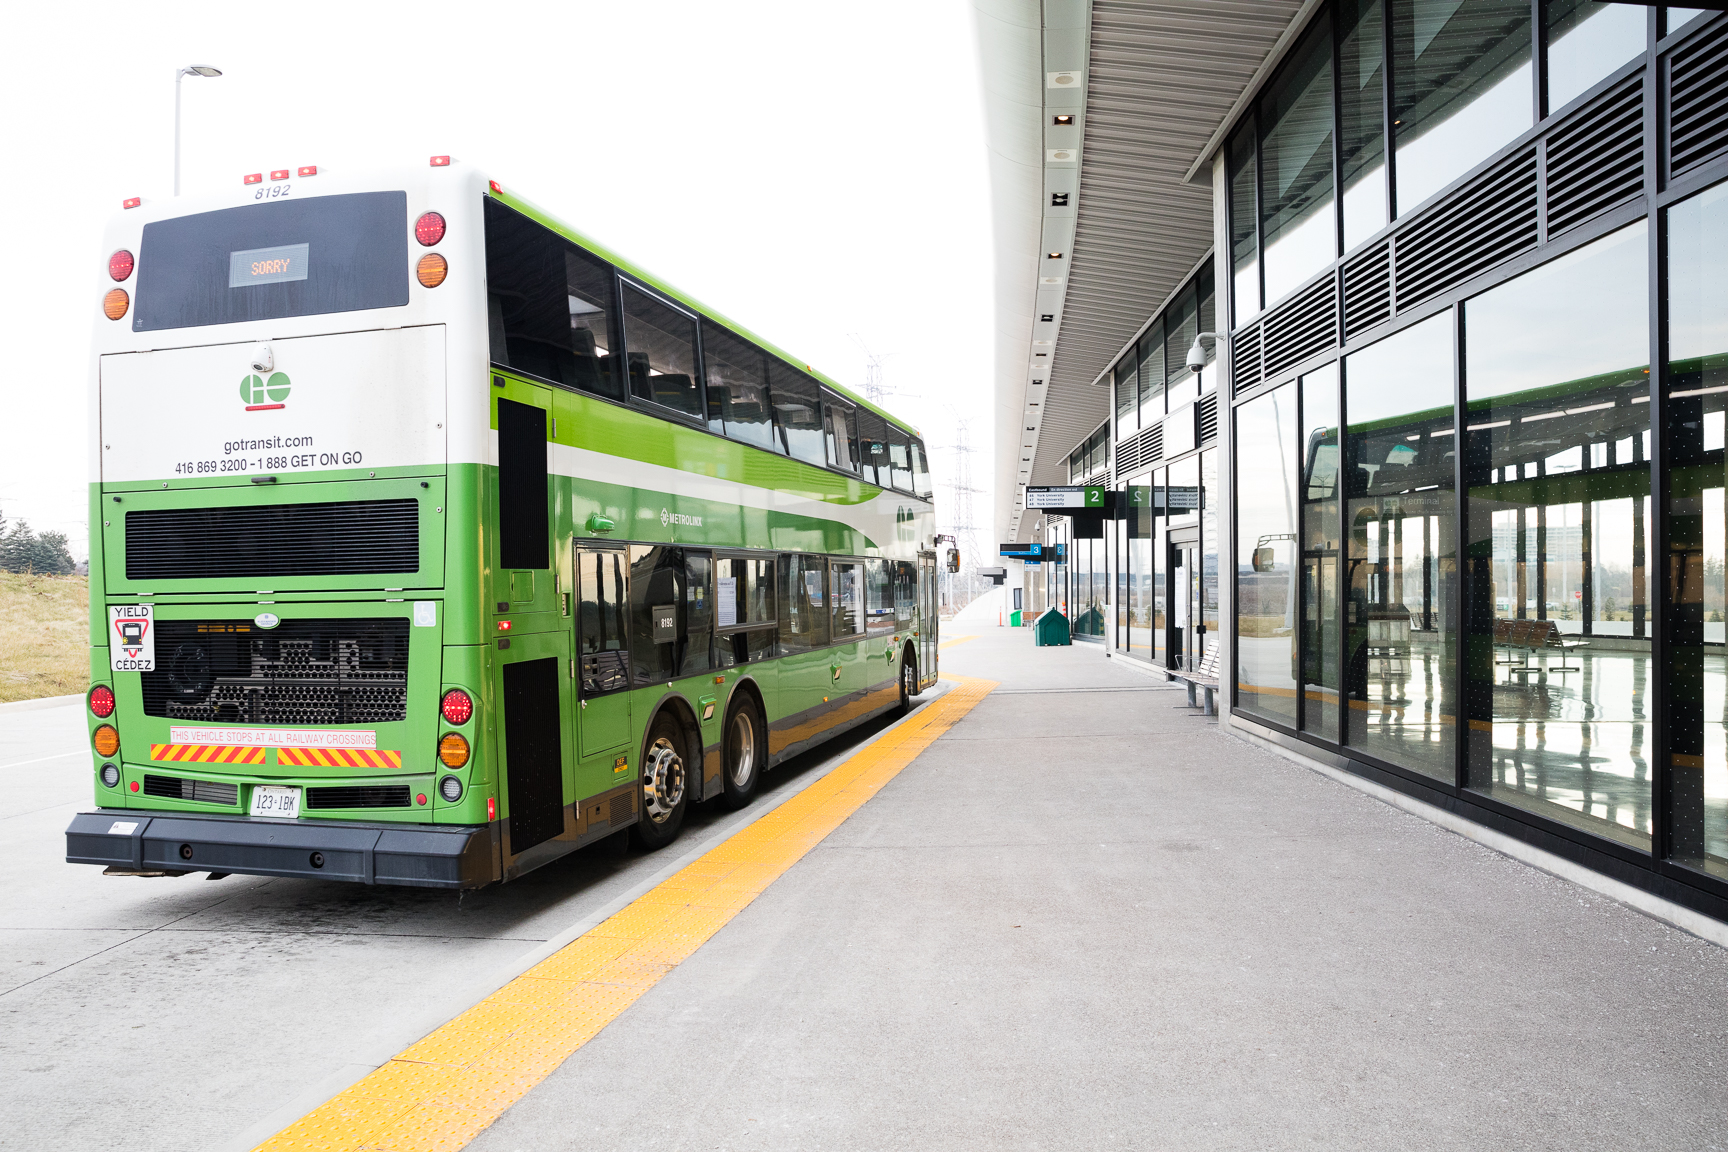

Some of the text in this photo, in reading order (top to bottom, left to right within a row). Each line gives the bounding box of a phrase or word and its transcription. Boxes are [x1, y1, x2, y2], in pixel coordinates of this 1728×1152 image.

[254, 184, 291, 200] 8192
[252, 258, 290, 275] SORRY
[224, 436, 313, 454] gotransit.com
[176, 463, 194, 474] 416
[197, 461, 217, 473] 869
[220, 459, 247, 472] 3200
[266, 456, 287, 469] 888
[291, 454, 316, 467] GET
[320, 452, 338, 466] ON
[342, 451, 362, 464] GO
[1091, 491, 1099, 502] 2
[1402, 496, 1439, 505] Terminal
[670, 513, 702, 527] METROLINX
[114, 607, 148, 617] YIELD
[661, 618, 673, 628] 8192
[116, 658, 151, 670] CÉDEZ
[172, 731, 376, 745] THIS VEHICLE STOPS AT ALL RAILWAY CROSSINGS
